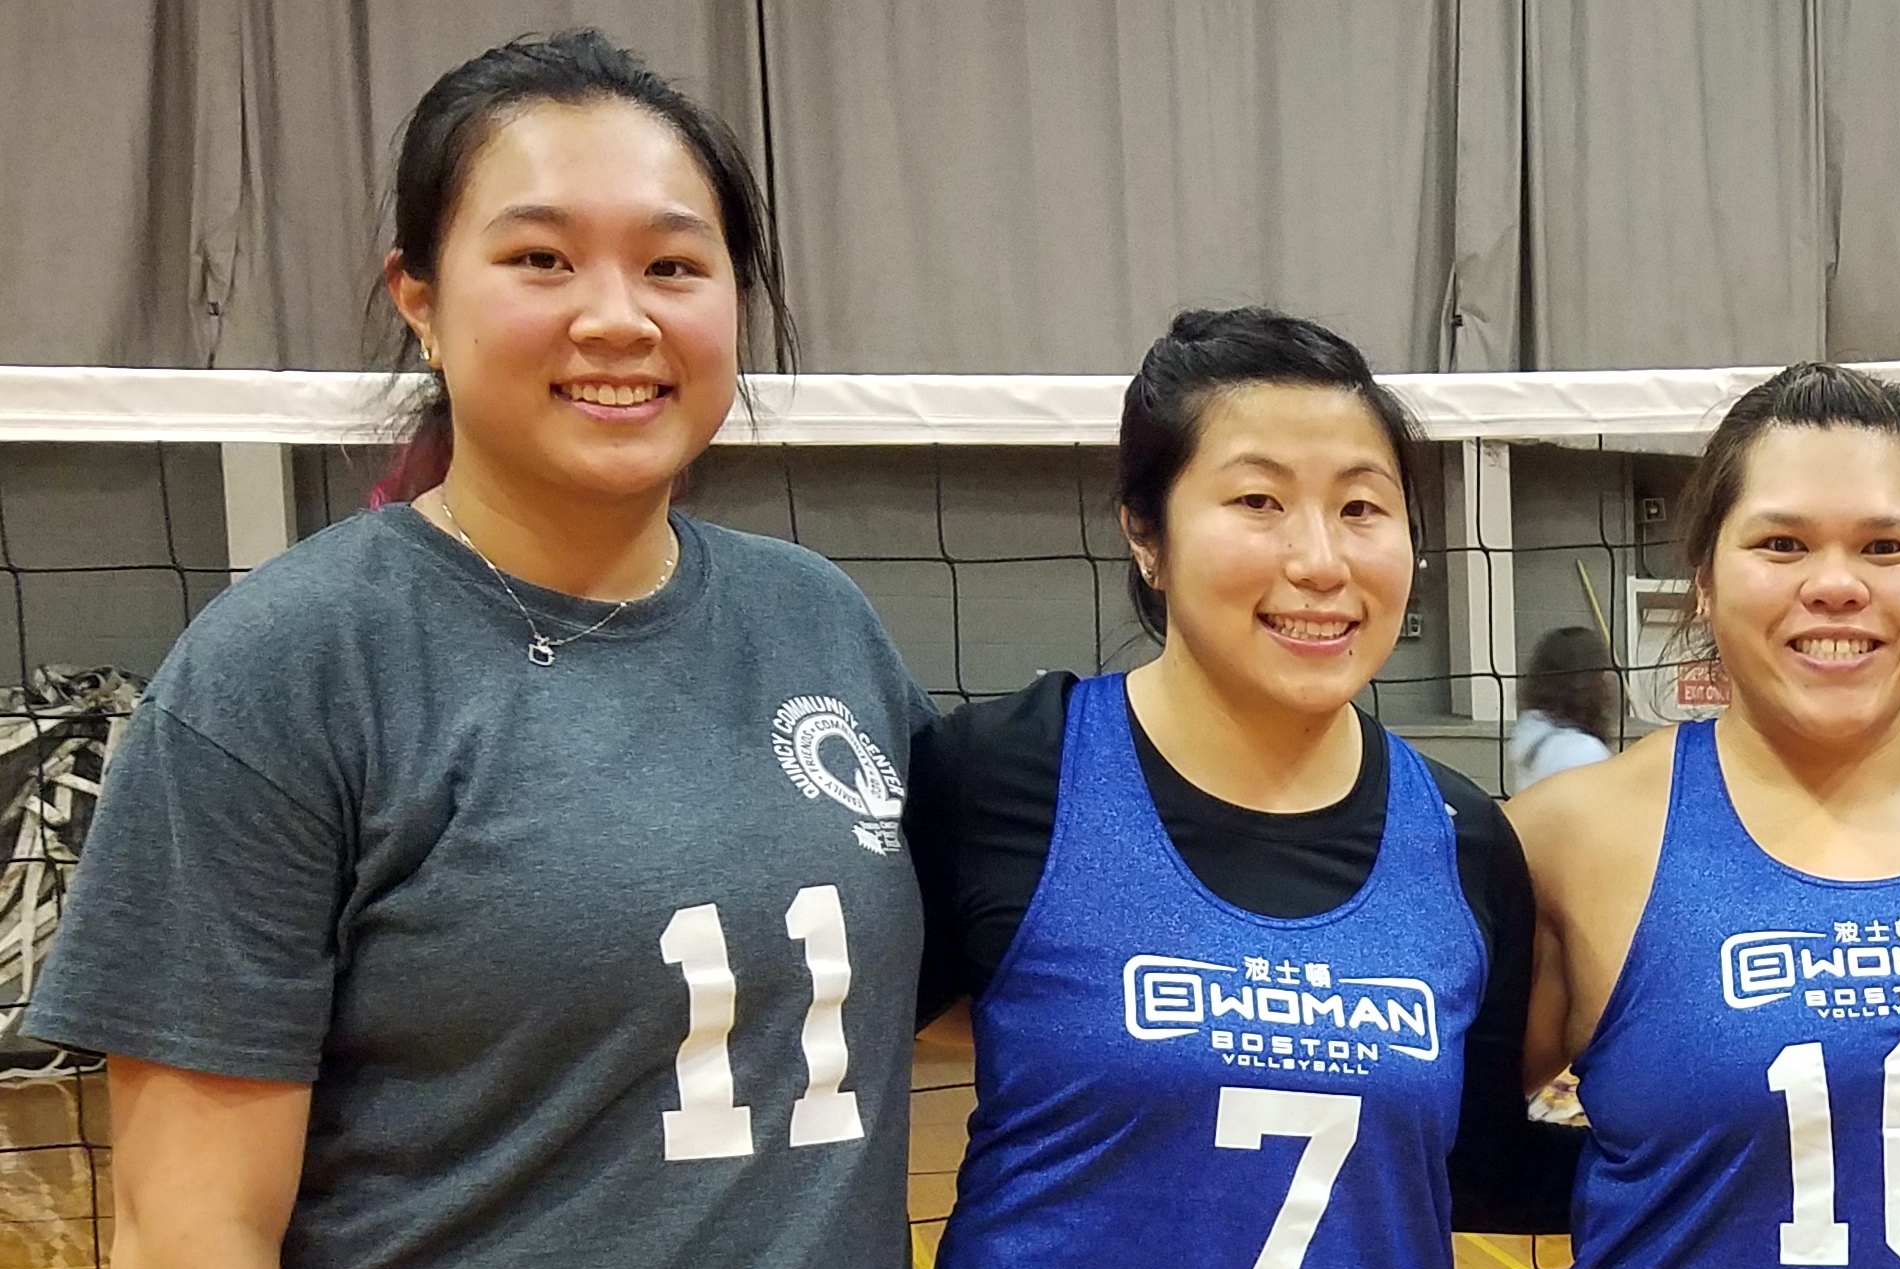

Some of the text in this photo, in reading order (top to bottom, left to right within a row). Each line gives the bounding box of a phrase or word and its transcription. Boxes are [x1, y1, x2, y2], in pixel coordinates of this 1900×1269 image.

[771, 695, 905, 799] QUINCY COMMUNITY CENTER
[800, 729, 817, 773] FRIENDS
[1243, 955, 1331, 989] 波士頓
[659, 883, 866, 1161] 11
[1211, 1030, 1380, 1061] BOSTON
[1222, 1053, 1370, 1075] VOLLEYBALL
